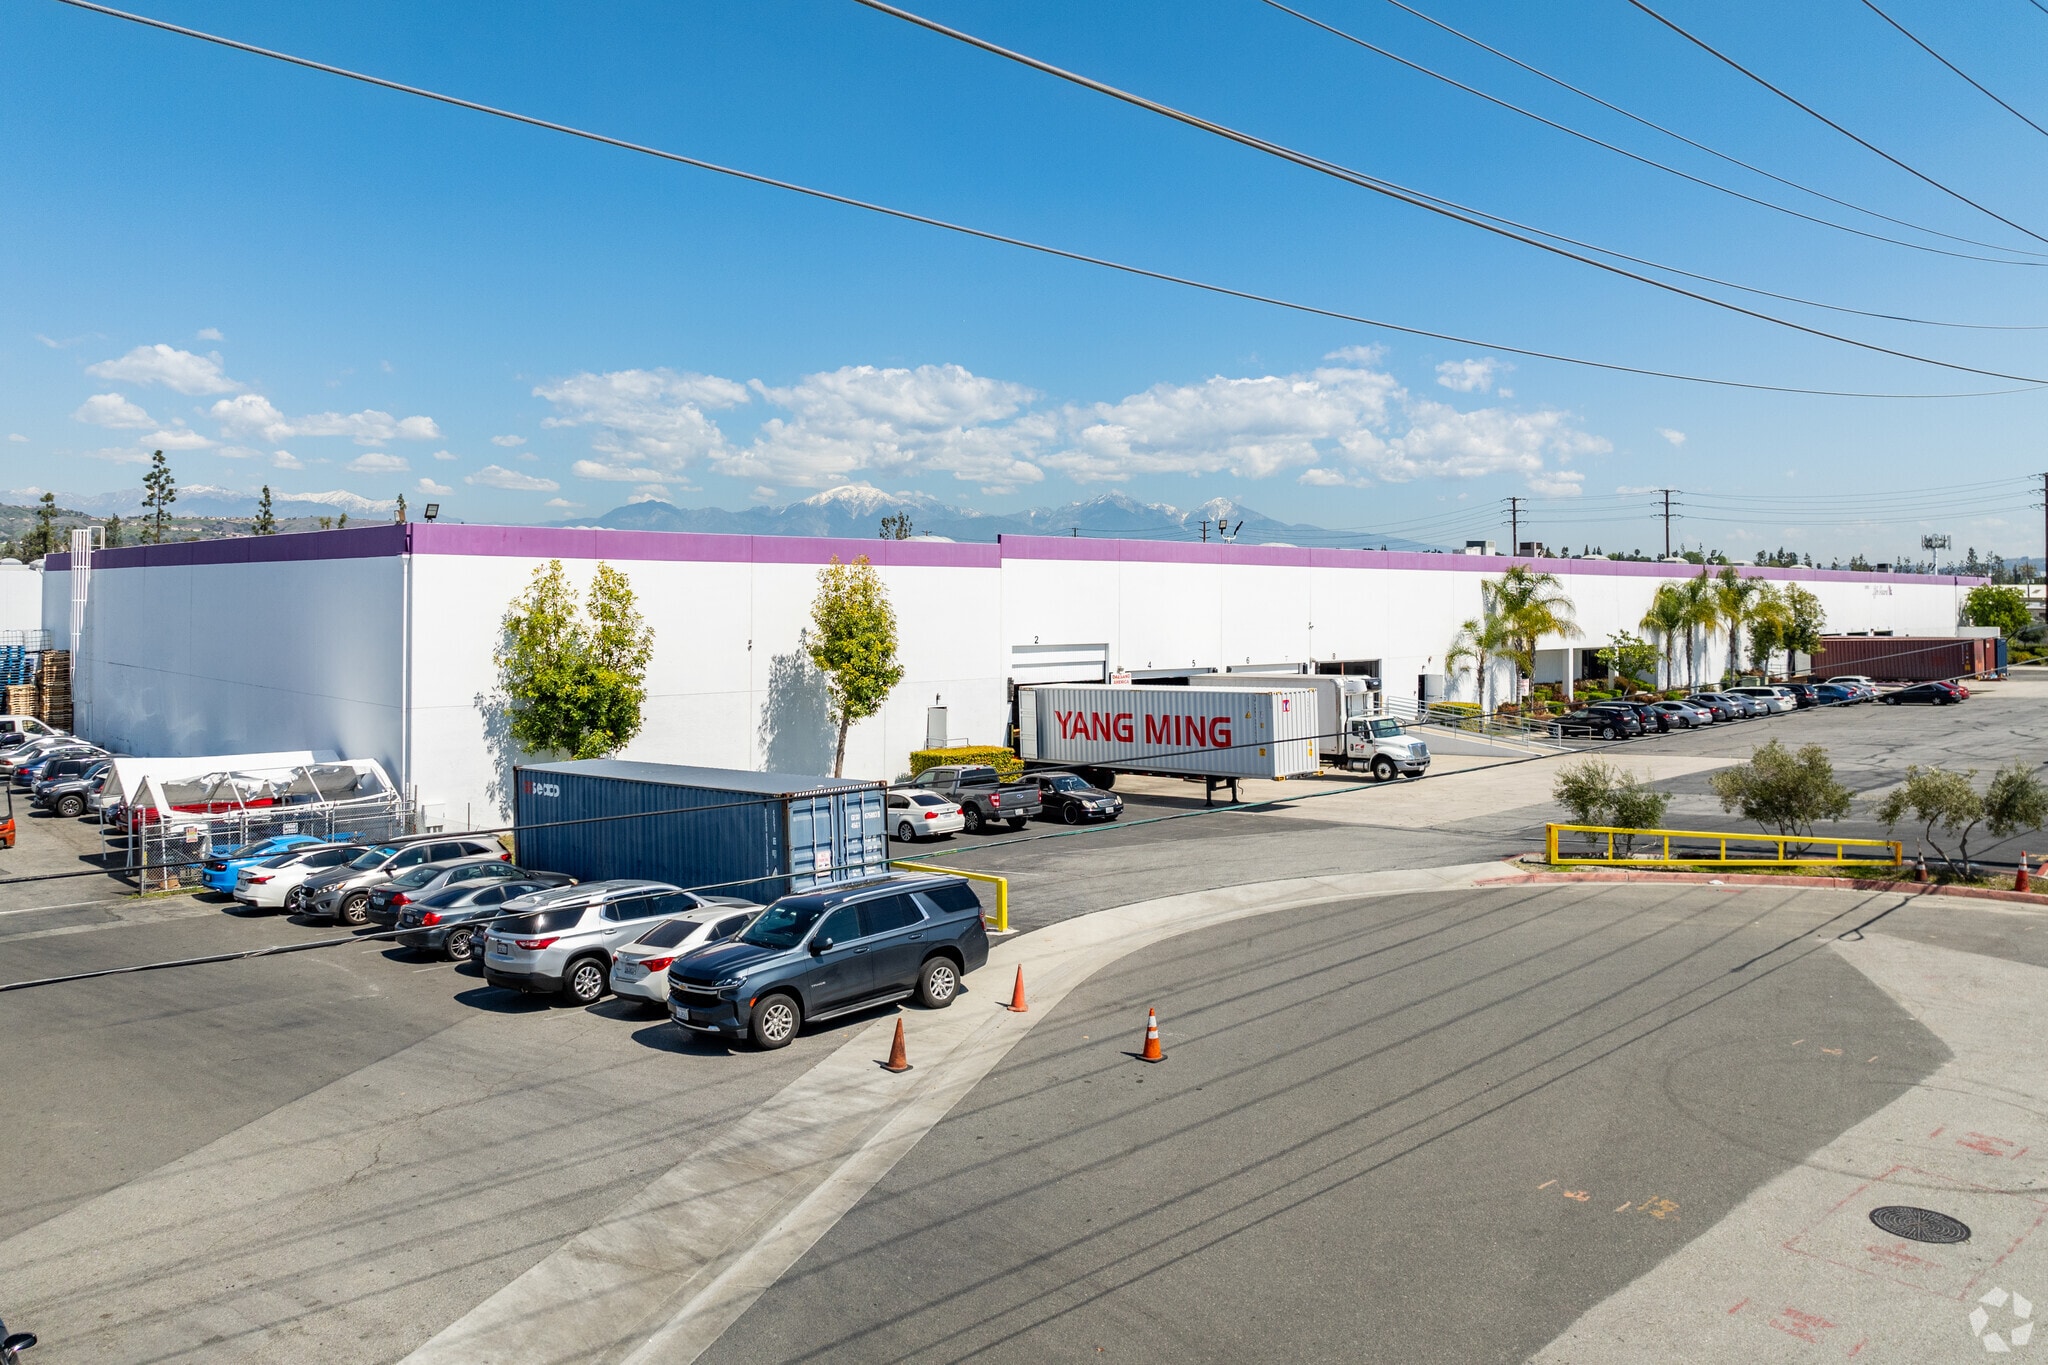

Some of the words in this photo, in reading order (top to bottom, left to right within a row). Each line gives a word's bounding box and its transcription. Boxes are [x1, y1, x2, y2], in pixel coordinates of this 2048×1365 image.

[1034, 635, 1039, 645] 2
[1147, 661, 1152, 669] 4
[1191, 659, 1196, 668] 5
[1055, 711, 1134, 743] YANG
[1145, 714, 1232, 749] MING
